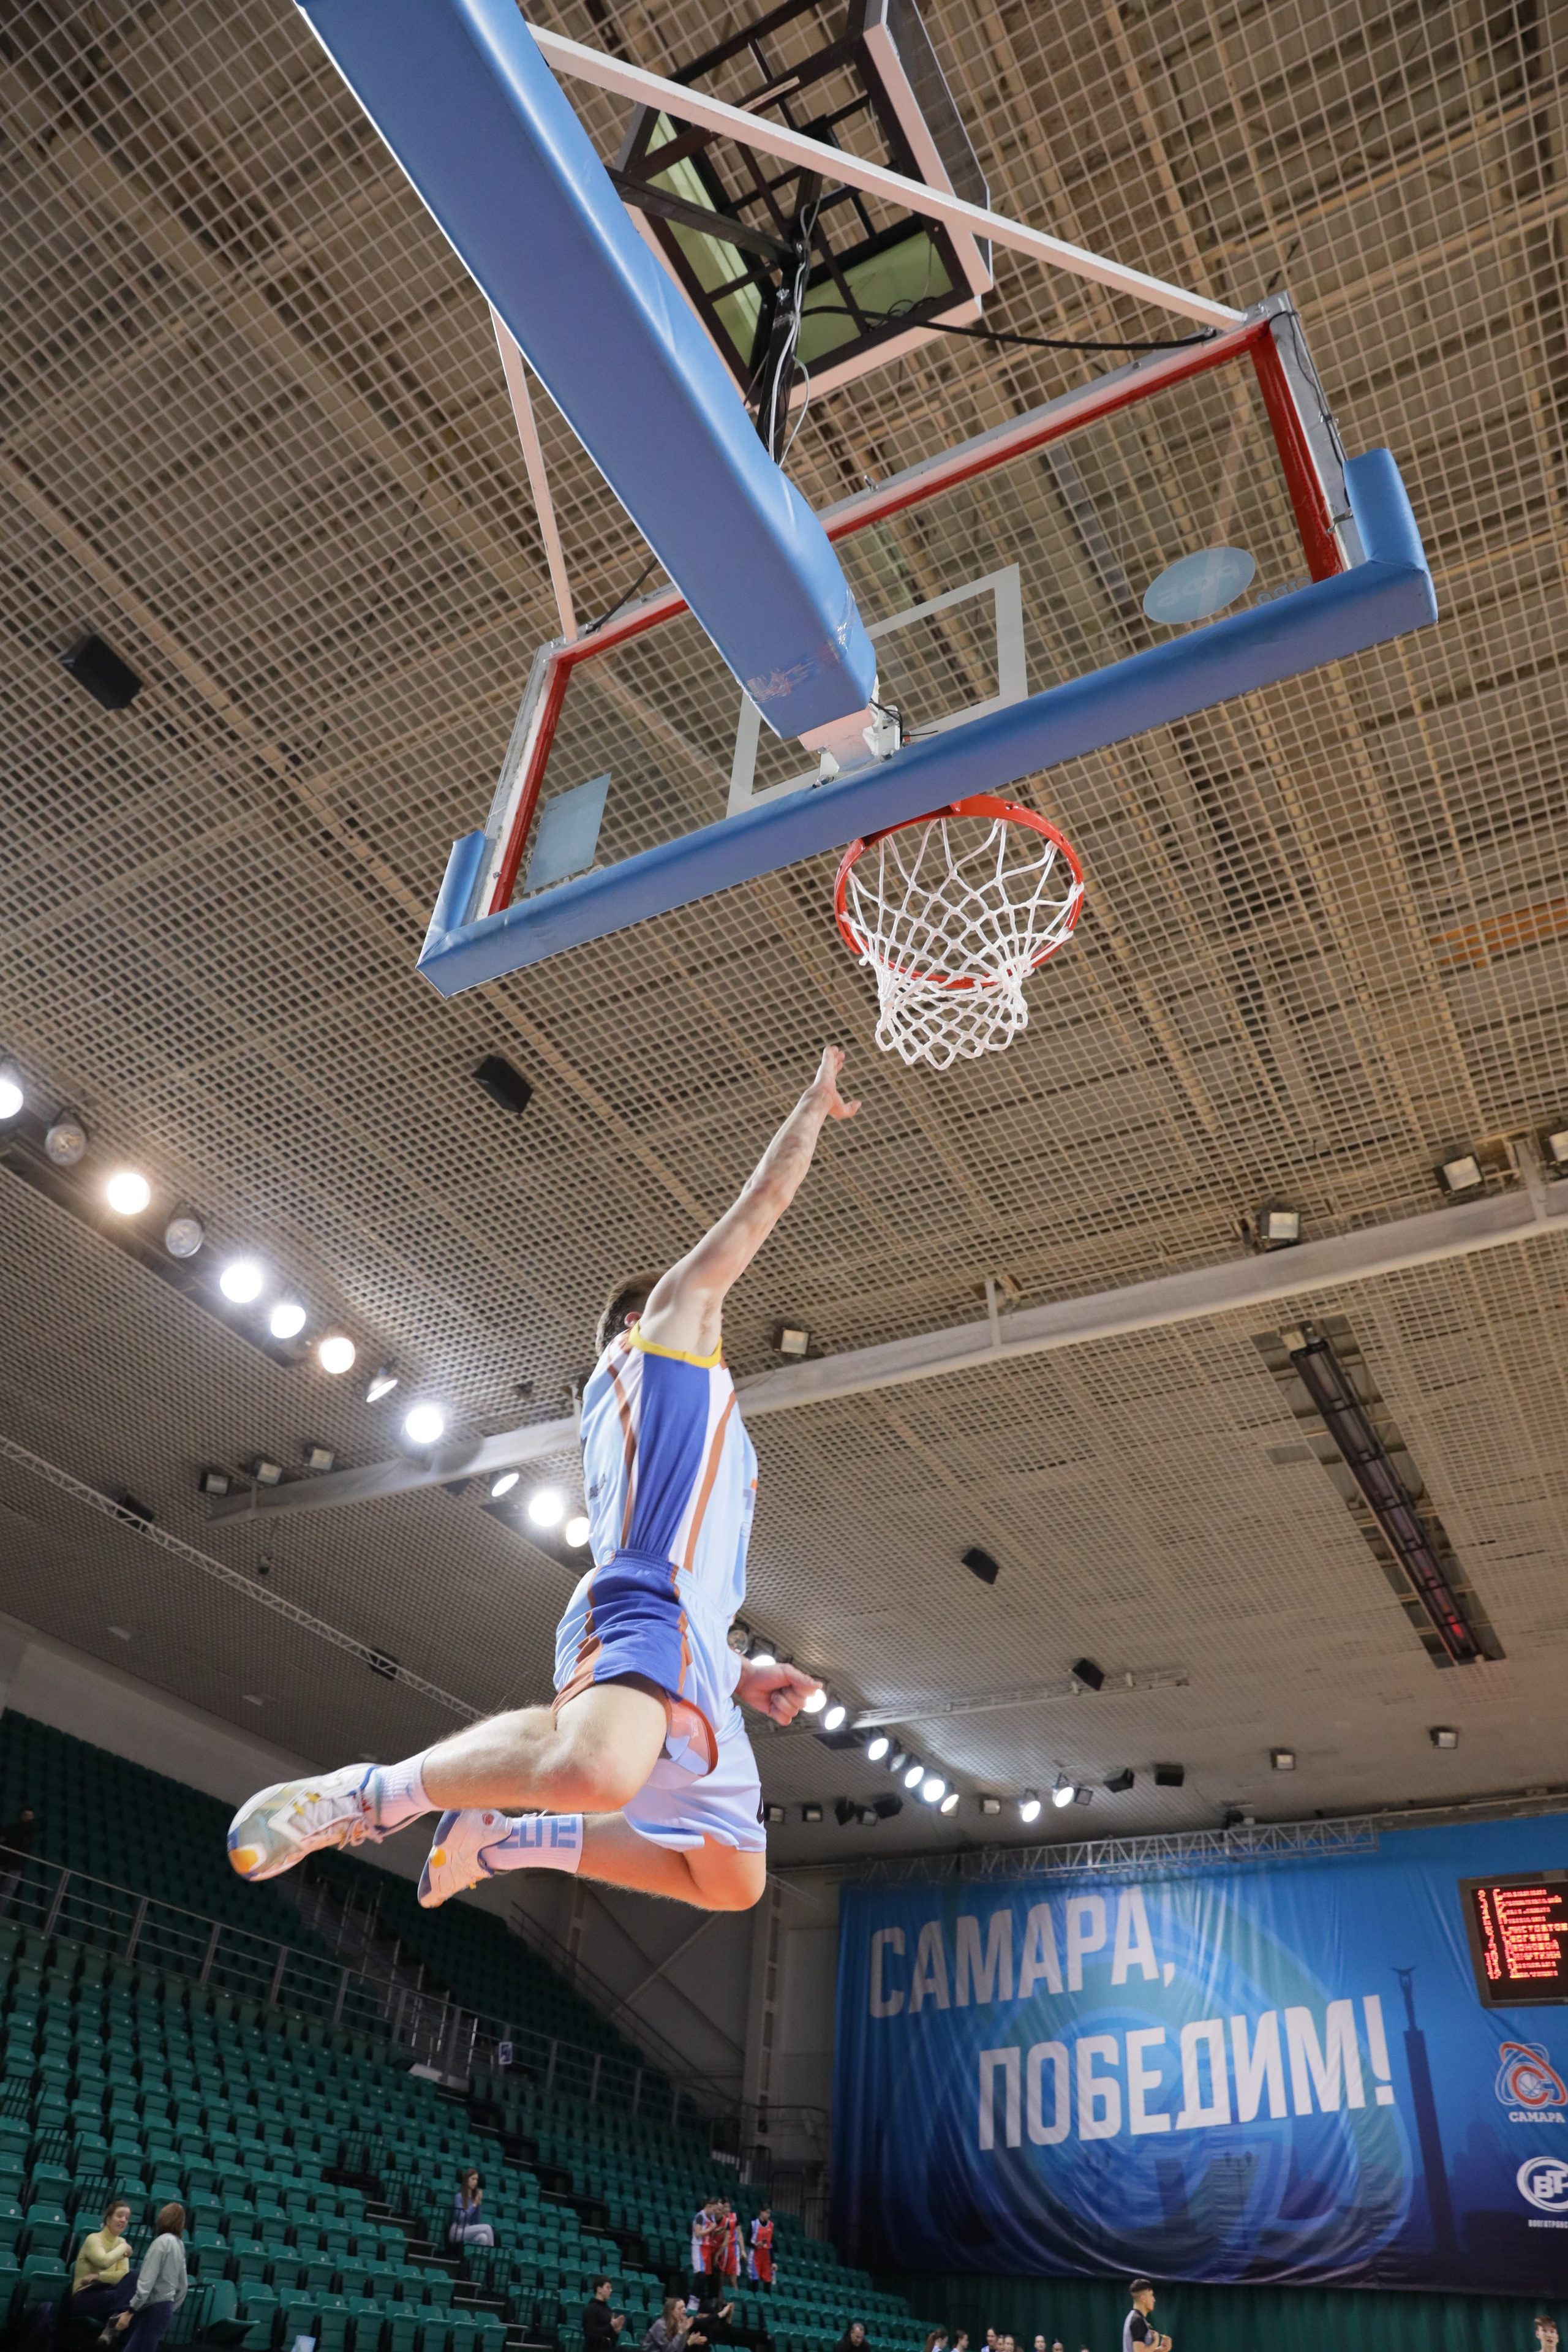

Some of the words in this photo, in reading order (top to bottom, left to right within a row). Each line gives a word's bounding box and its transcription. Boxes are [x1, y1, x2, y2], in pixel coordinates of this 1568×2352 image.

[869, 1888, 1176, 2018] САМАРА,
[979, 1994, 1395, 2150] ПОБЕДИМ!
[1508, 2111, 1566, 2123] САМАРА
